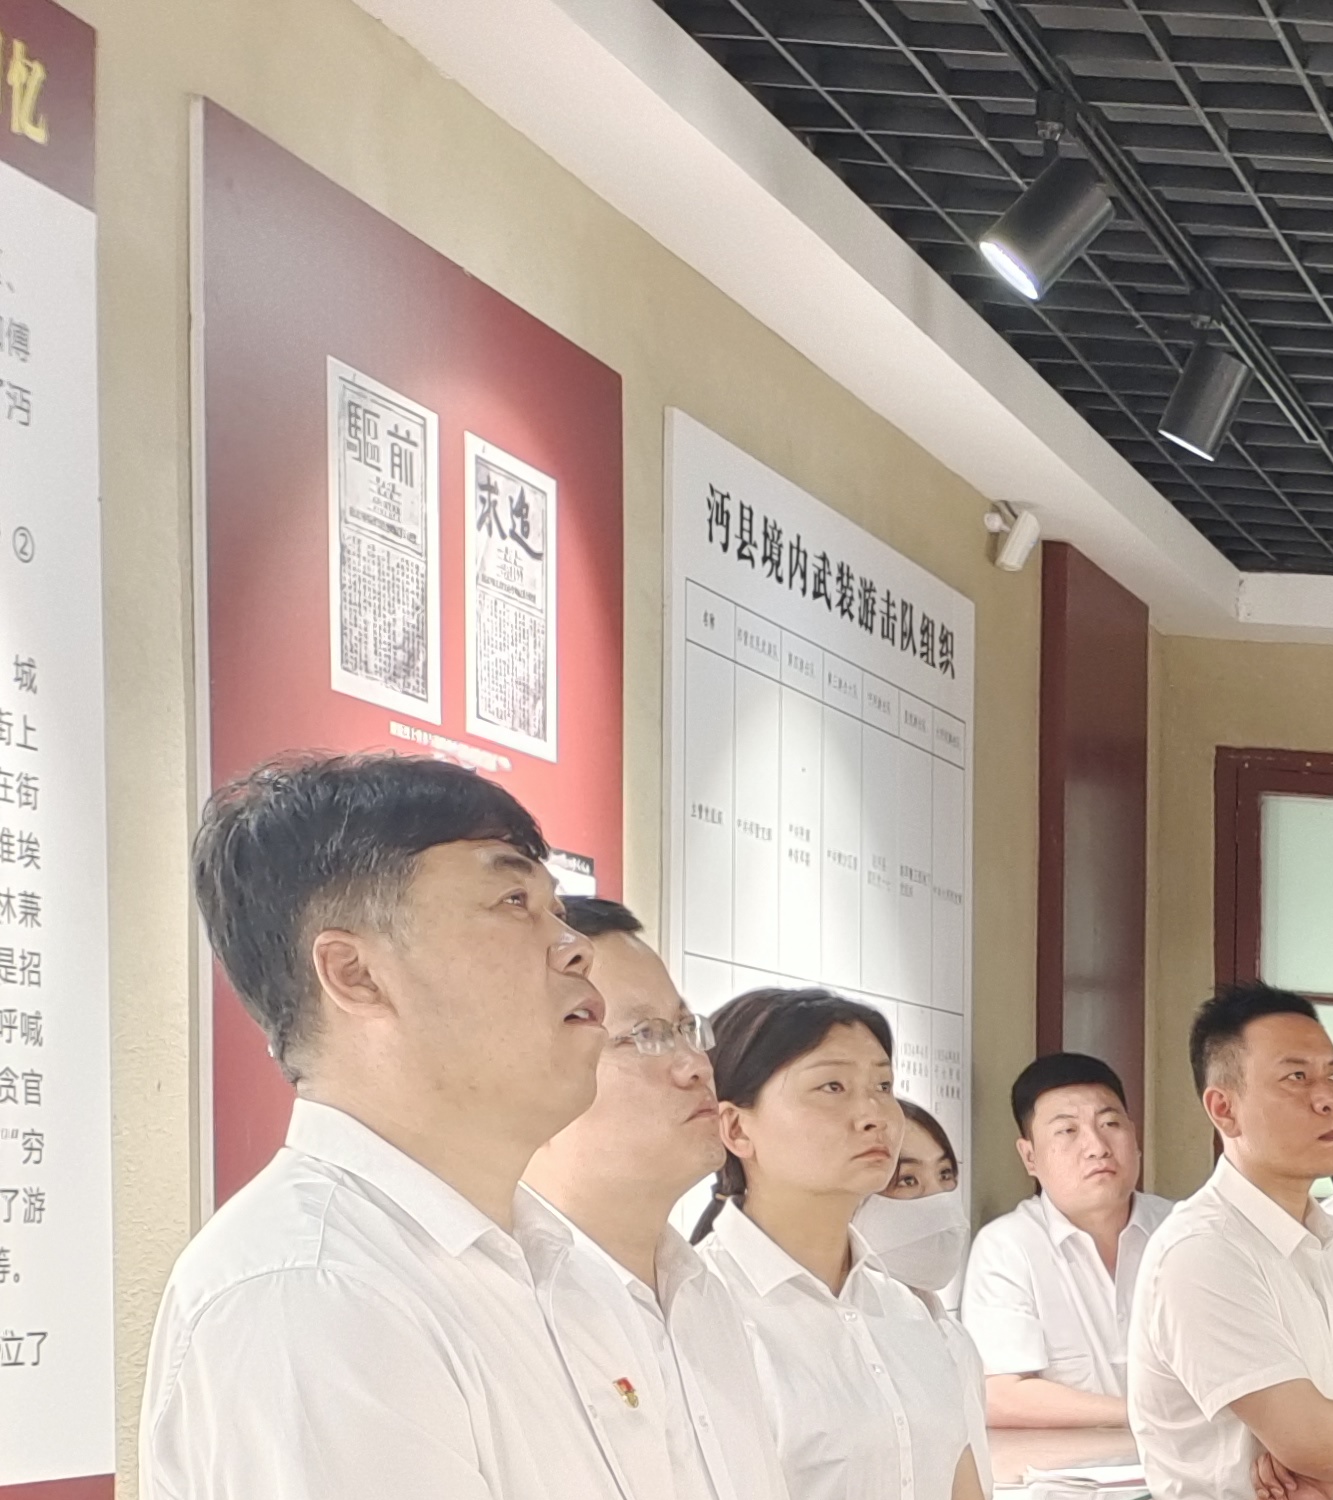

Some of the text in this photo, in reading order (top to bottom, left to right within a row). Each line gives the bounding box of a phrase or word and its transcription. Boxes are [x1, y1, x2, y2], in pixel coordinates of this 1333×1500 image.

[7, 38, 50, 146] 忆
[706, 482, 956, 680] 沔县境内武装游击队组织
[13, 654, 37, 694] 城
